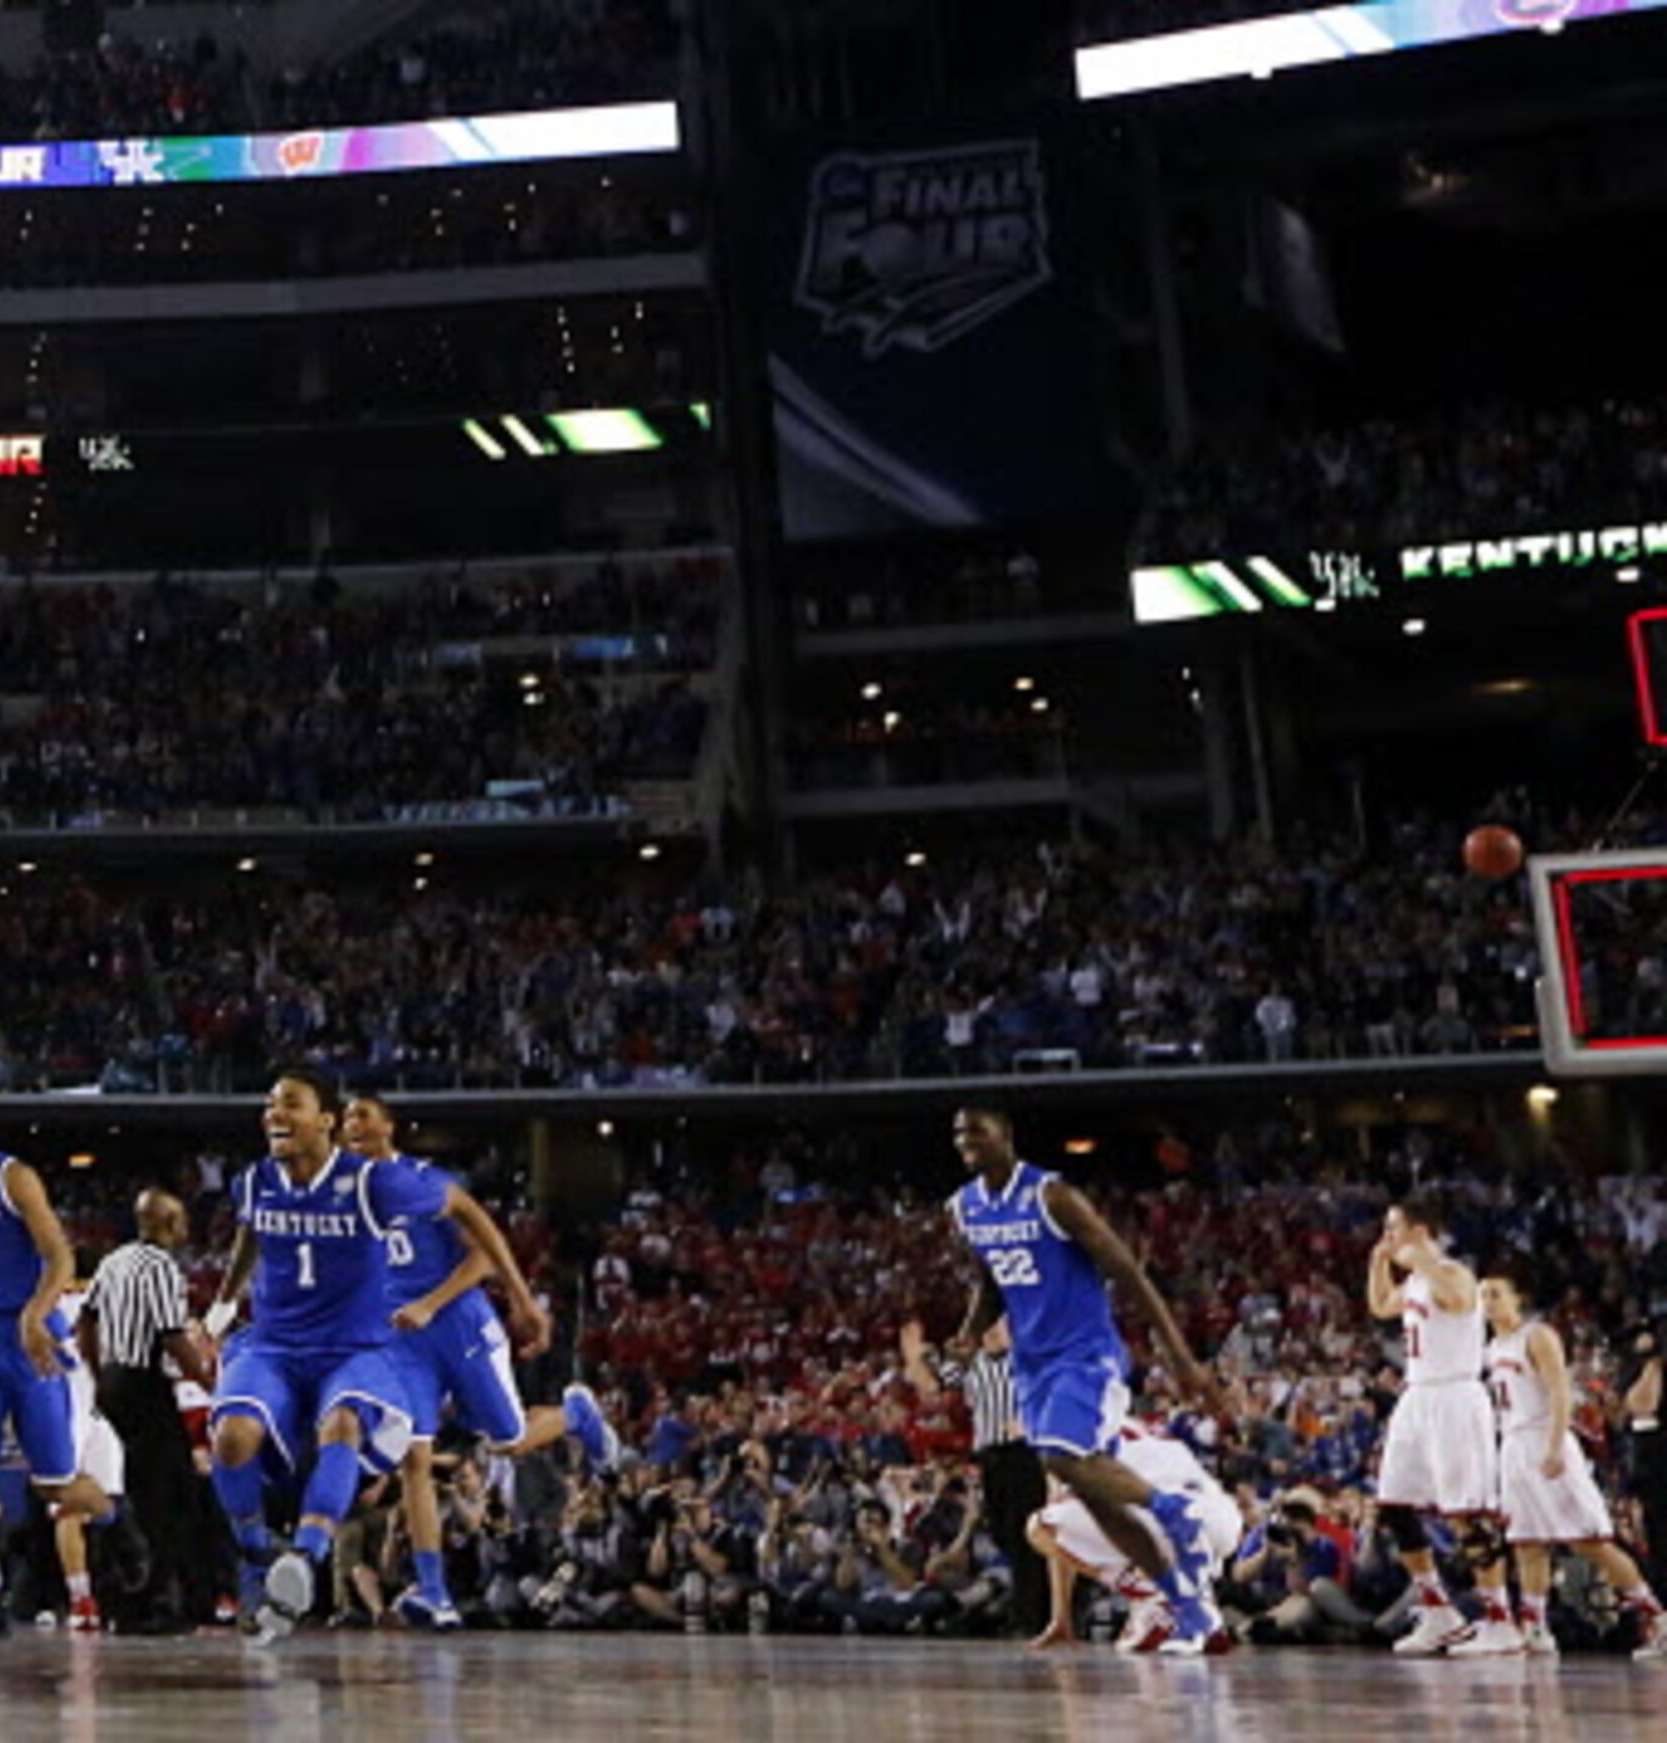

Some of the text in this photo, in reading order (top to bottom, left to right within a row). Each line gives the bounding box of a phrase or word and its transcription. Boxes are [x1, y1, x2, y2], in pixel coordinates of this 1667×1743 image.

[872, 164, 1027, 224] FINAL
[812, 211, 1033, 294] FOUR
[253, 1208, 357, 1237] KENTUCKY
[296, 1241, 316, 1288] 1
[986, 1247, 1042, 1287] 22
